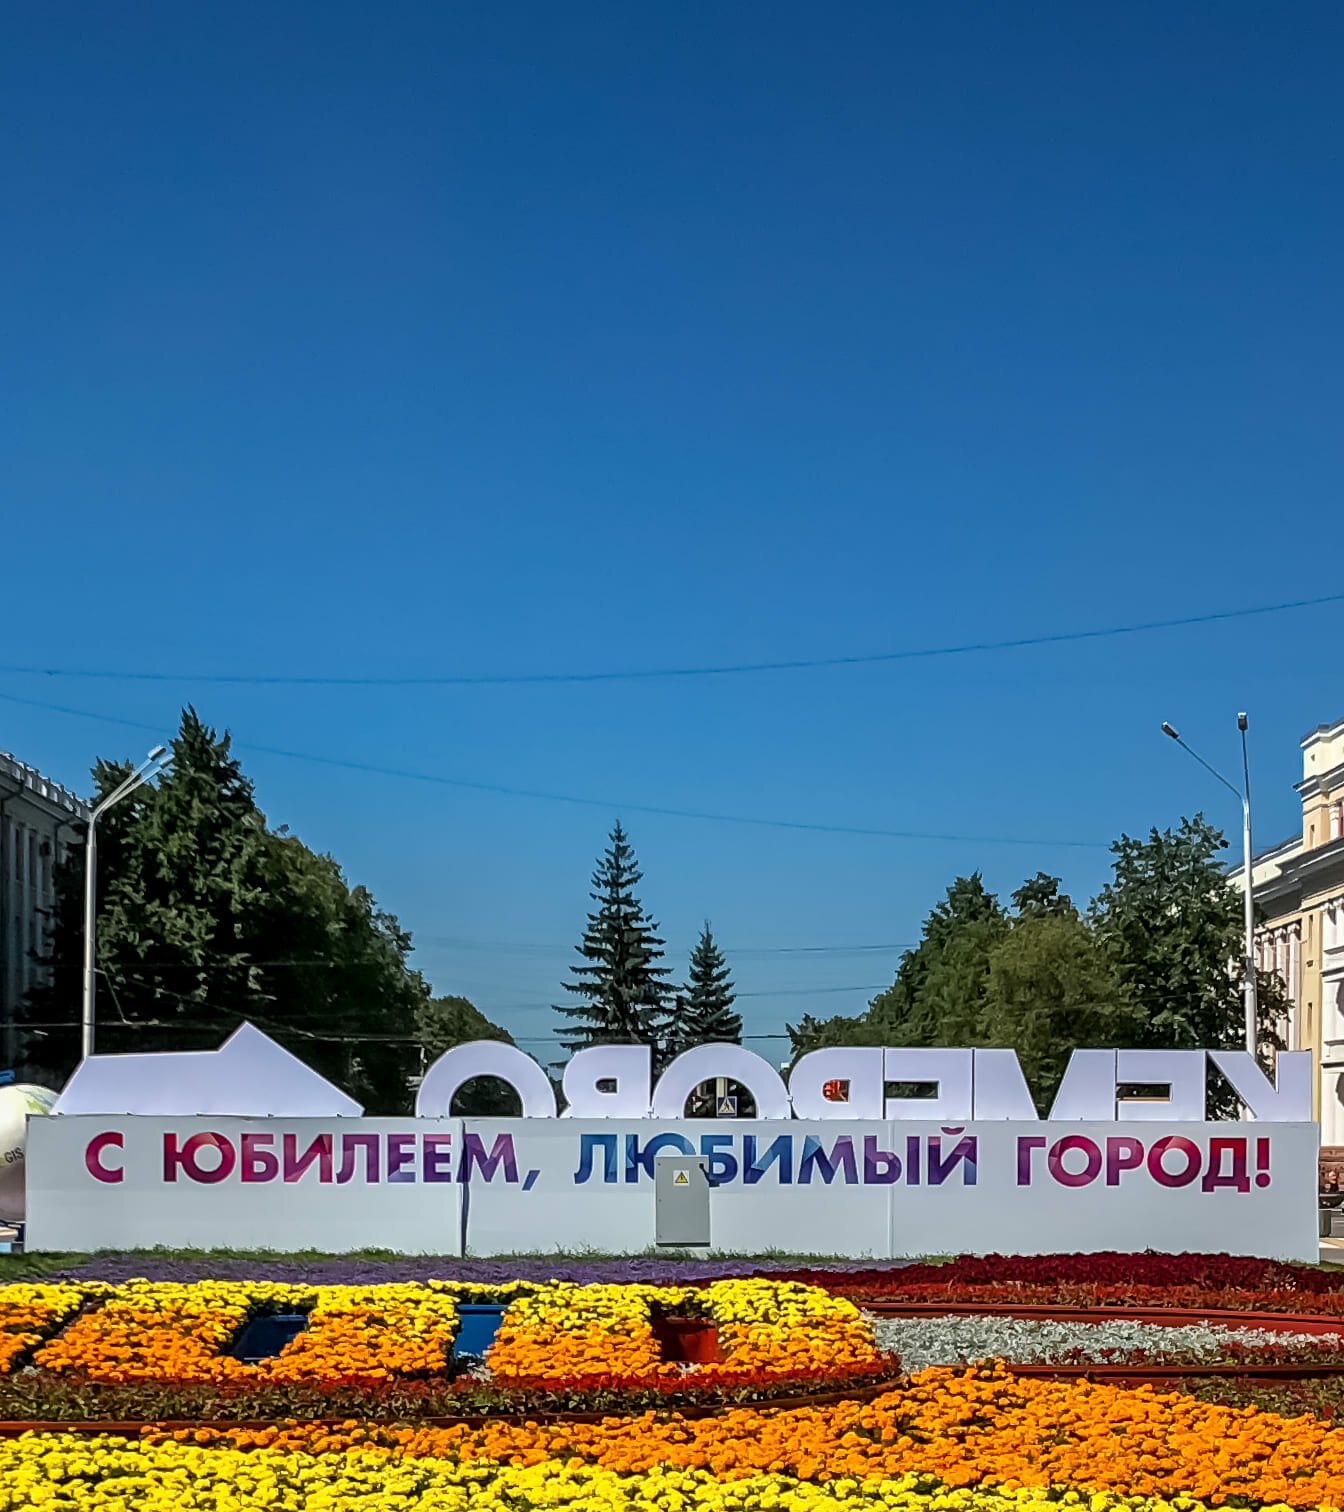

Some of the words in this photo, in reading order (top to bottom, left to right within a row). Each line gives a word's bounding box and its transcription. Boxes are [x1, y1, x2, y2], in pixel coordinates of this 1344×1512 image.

[85, 1131, 124, 1184] С
[163, 1131, 541, 1192] ЮБИЛЕЕМ,
[573, 1126, 978, 1186] ЛЮБИМЫЙ
[1017, 1134, 1271, 1193] ГОРОД!
